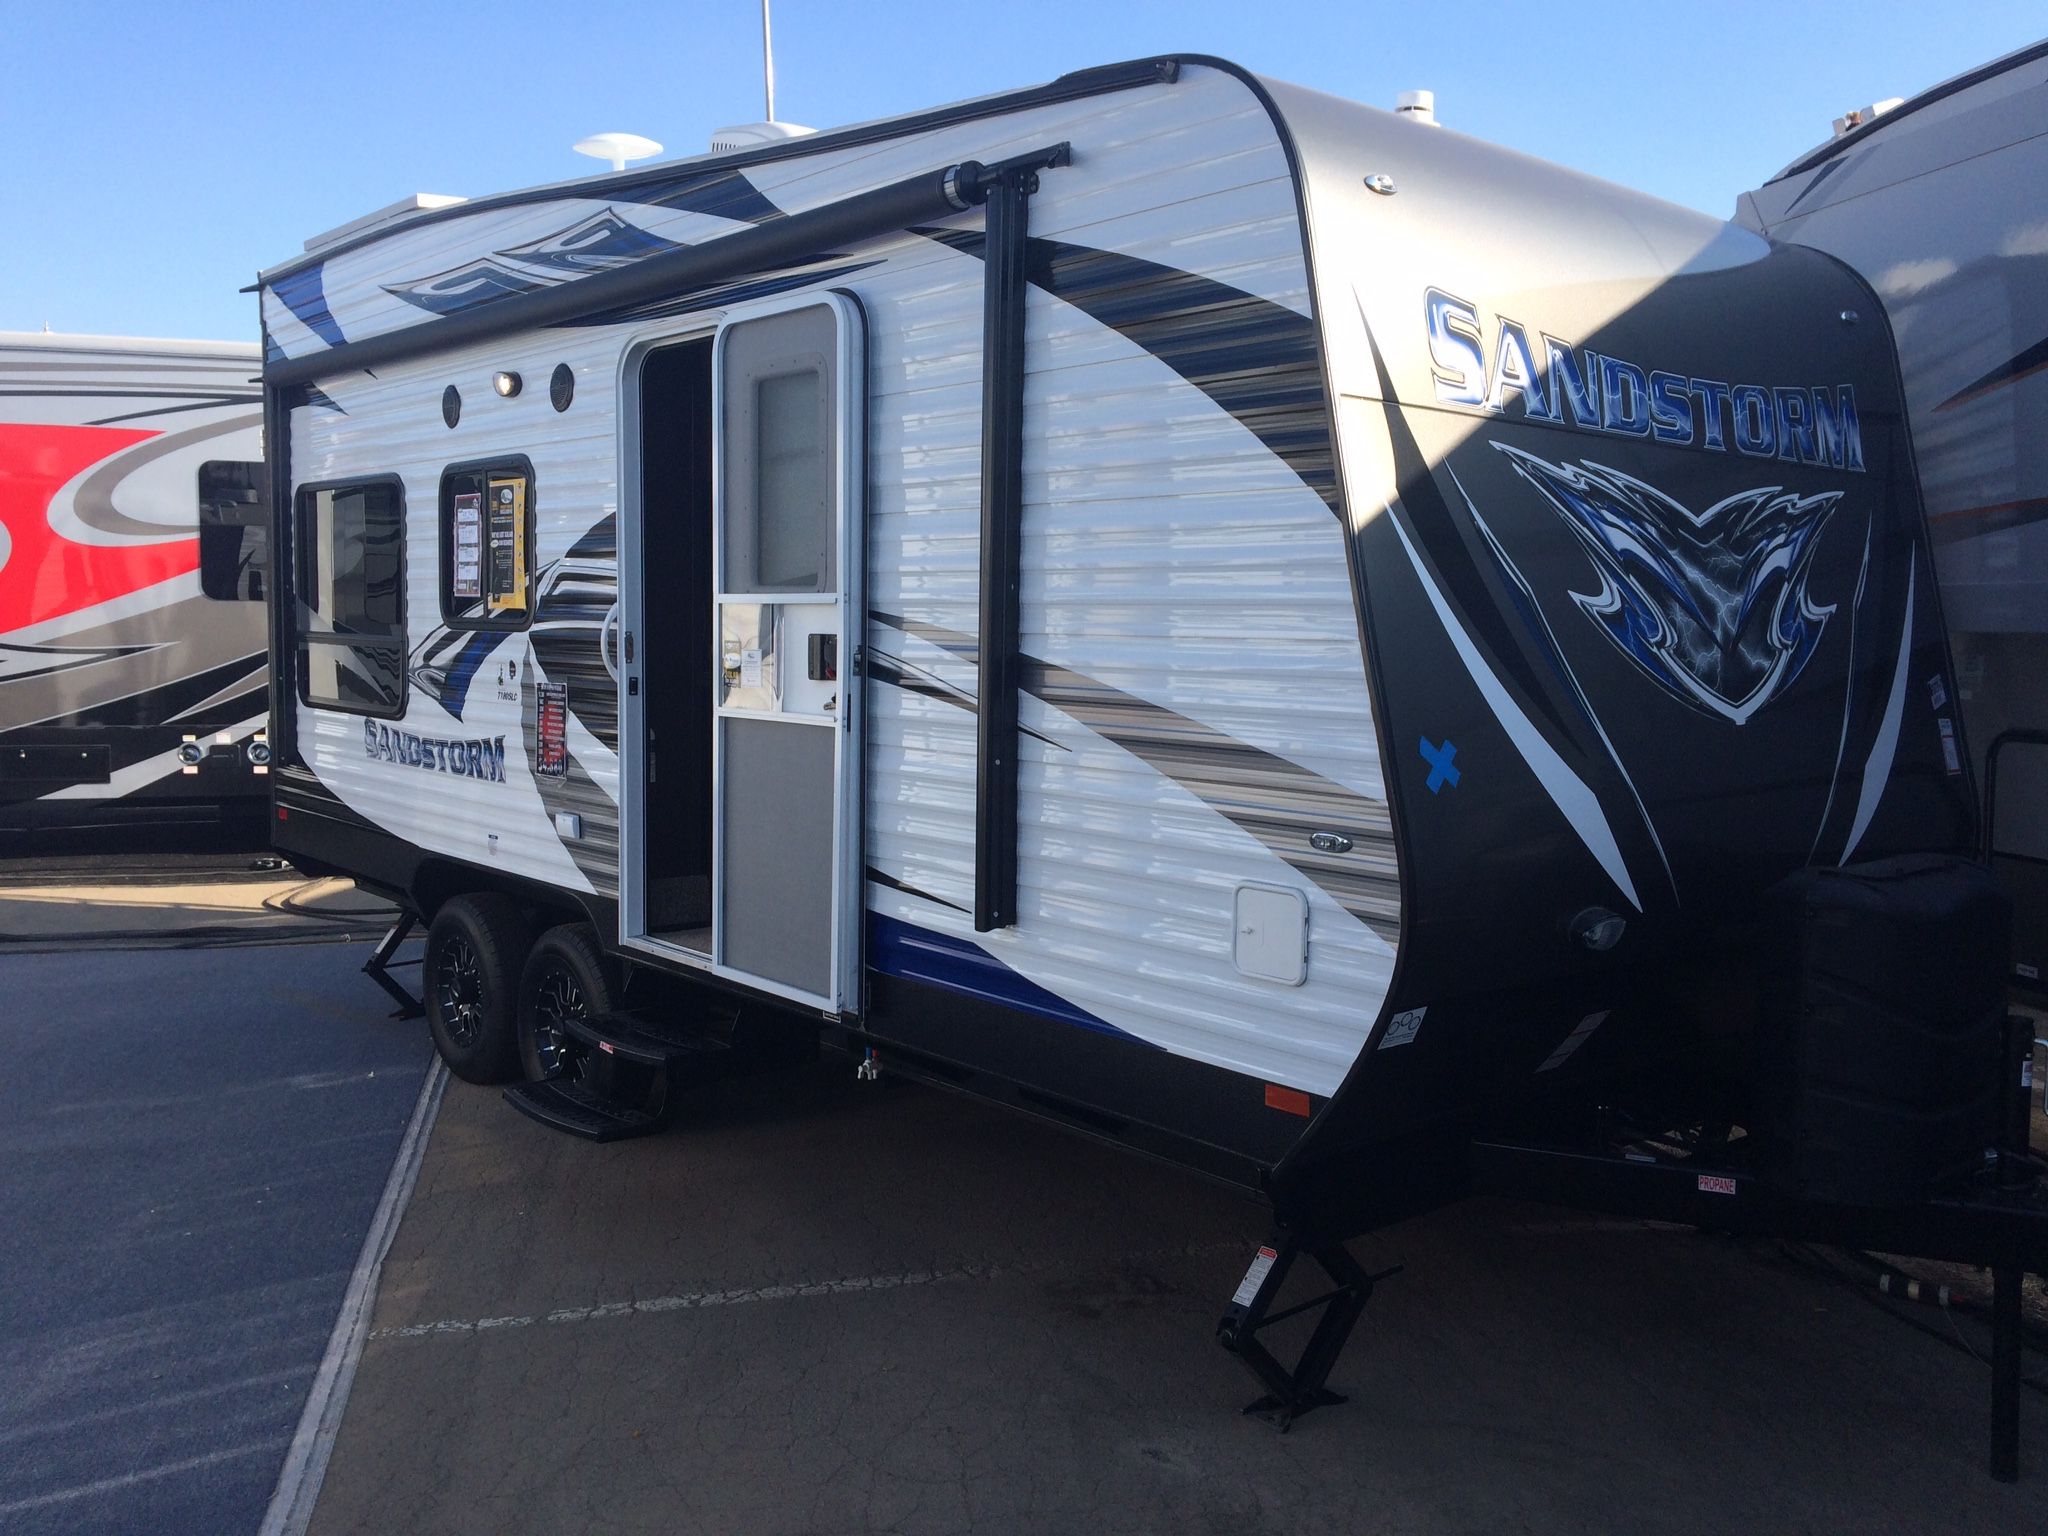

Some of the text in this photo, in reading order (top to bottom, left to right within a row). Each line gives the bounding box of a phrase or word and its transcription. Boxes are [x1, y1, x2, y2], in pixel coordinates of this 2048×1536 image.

[1424, 285, 1866, 473] SANDSTORM
[364, 717, 506, 783] SANDSTORM
[1699, 1176, 1735, 1193] PROPANE
